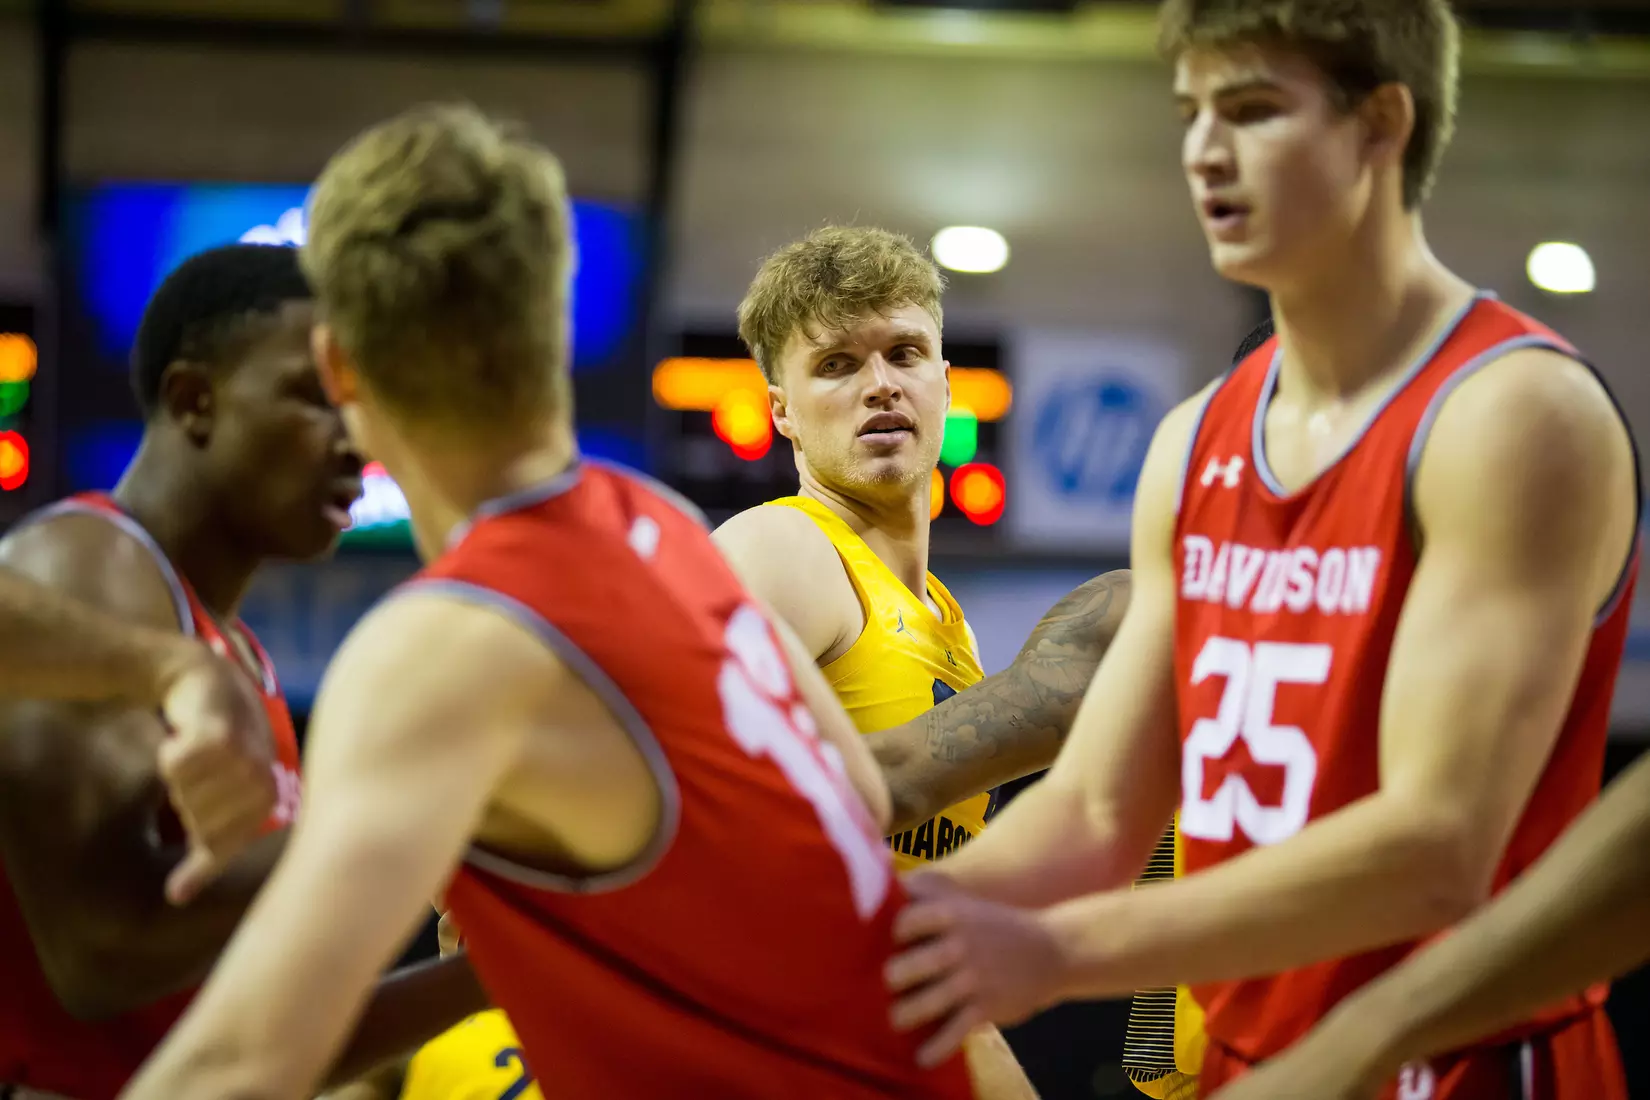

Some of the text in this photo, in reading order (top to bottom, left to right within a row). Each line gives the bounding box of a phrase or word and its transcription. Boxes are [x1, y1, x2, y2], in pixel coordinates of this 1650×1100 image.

[1181, 533, 1382, 615] DAVIDSON
[1179, 635, 1333, 847] 25
[883, 815, 972, 862] MAR
